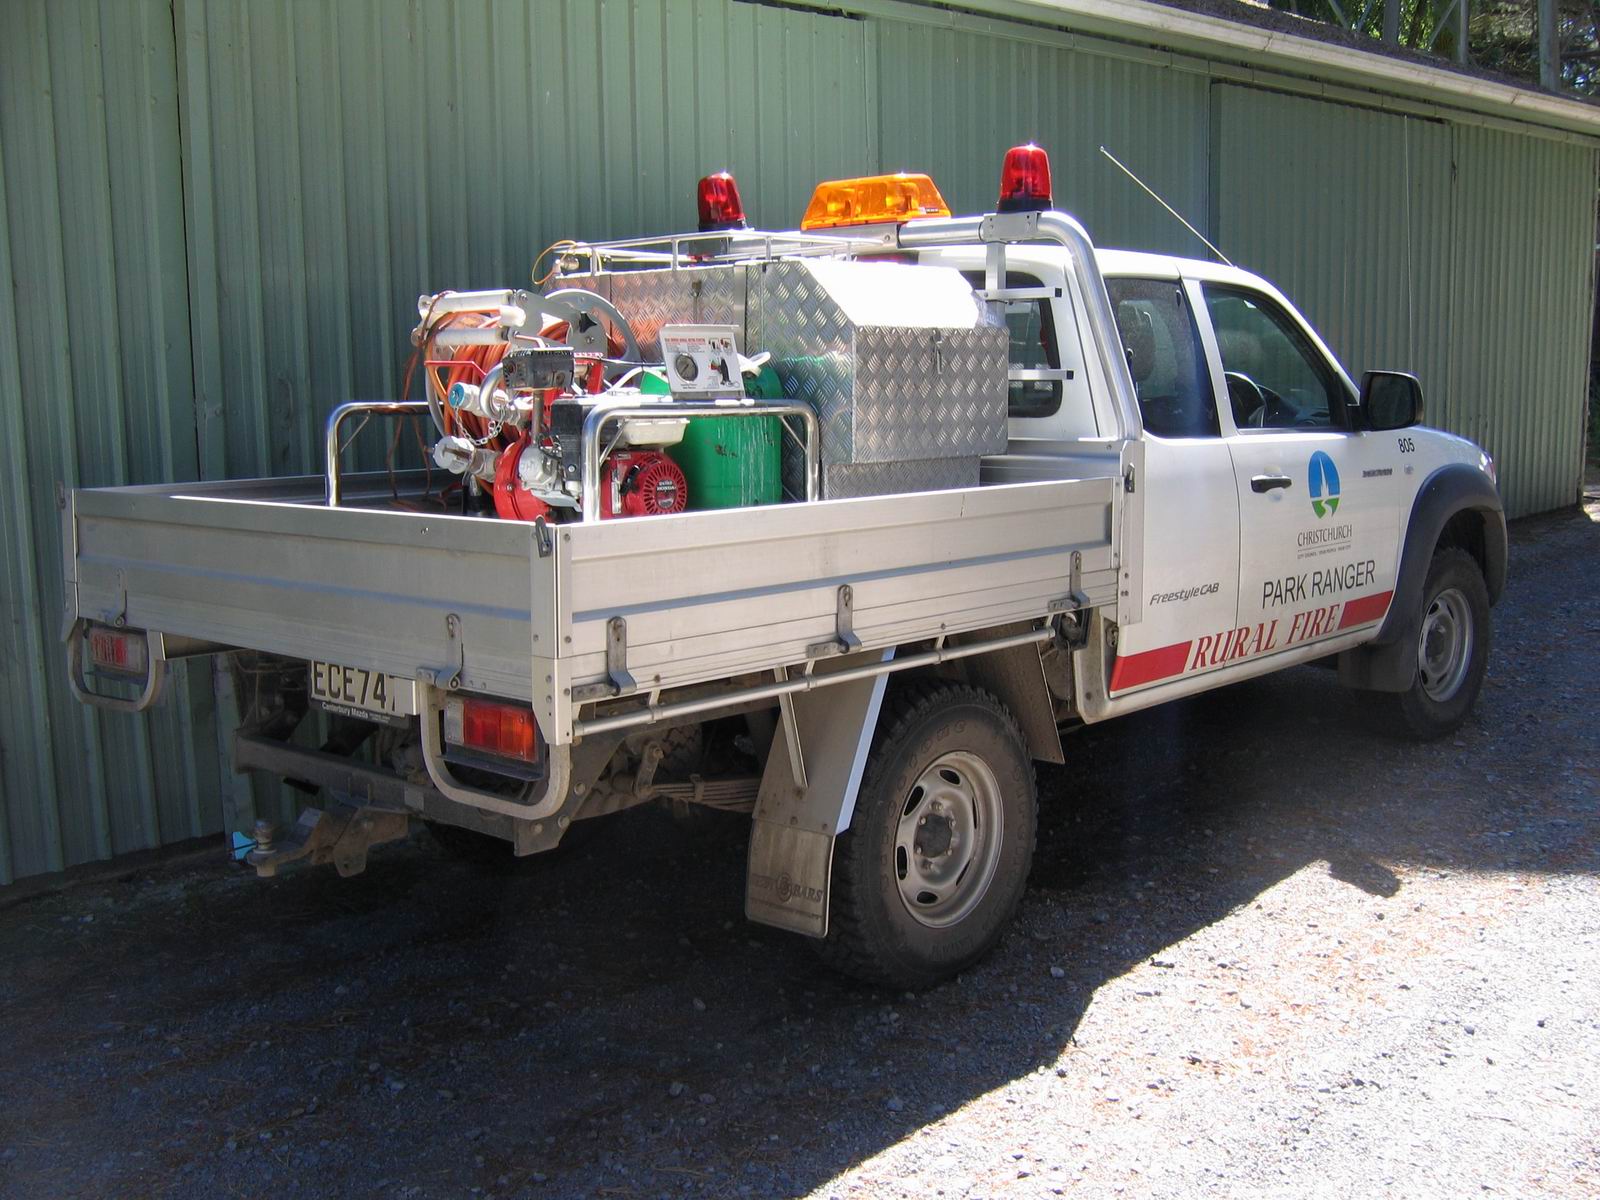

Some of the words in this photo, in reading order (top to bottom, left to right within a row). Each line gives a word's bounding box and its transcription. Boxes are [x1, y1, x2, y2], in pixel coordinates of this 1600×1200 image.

[1397, 437, 1415, 453] 805
[1297, 524, 1352, 547] CHRISTCHURCH
[1262, 574, 1308, 609] PARK
[1311, 560, 1376, 598] RANGER
[1189, 619, 1279, 671] RURAL
[1286, 603, 1341, 645] FIRE
[313, 660, 396, 712] ECE74
[321, 701, 351, 717] Canterbury
[351, 707, 369, 719] Mazda
